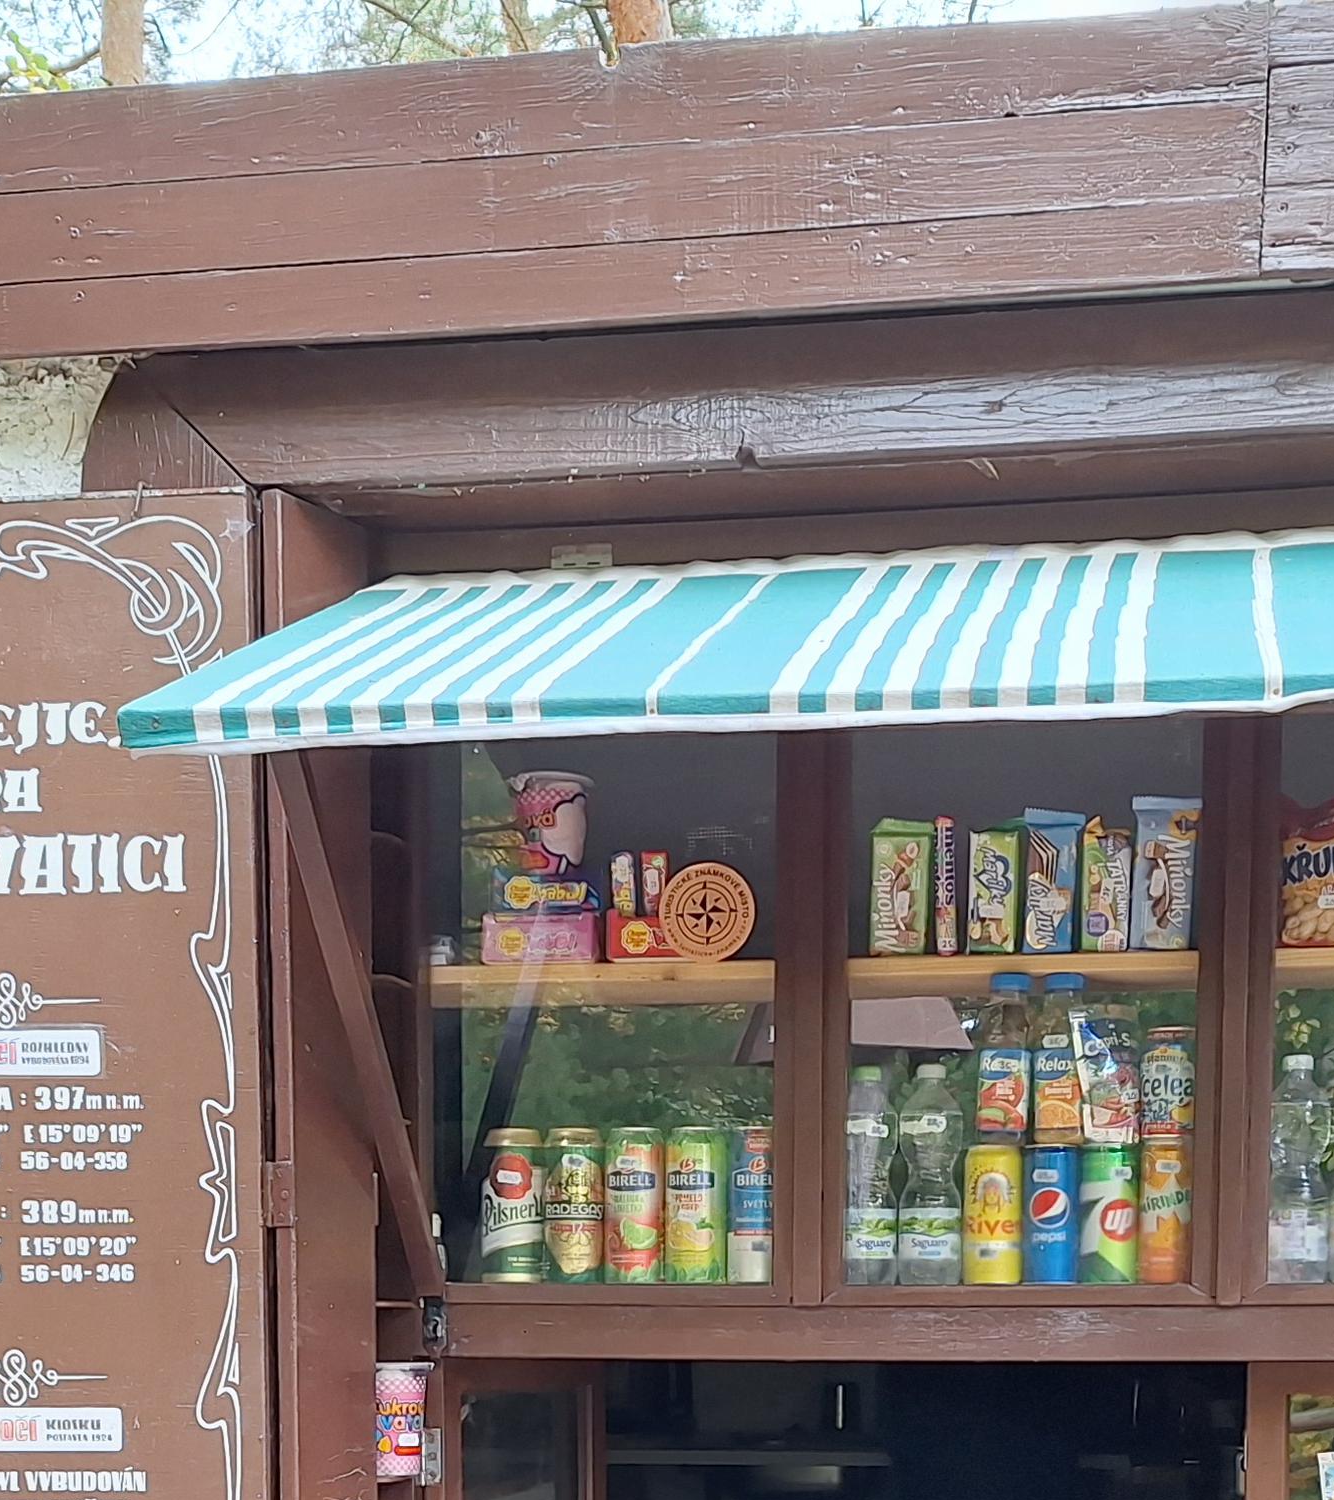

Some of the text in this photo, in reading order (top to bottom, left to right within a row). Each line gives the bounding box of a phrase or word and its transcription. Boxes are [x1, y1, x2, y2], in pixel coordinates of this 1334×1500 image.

[943, 826, 957, 908] mentos
[20, 1150, 128, 1171] 56-04-358
[608, 1174, 653, 1187] BIRELL
[669, 1174, 711, 1186] BIRELL
[856, 1238, 892, 1250] Saguaro
[911, 1238, 948, 1250] Saguaro
[20, 1264, 135, 1283] 56-04-346
[46, 1419, 101, 1431] KIOSKU
[24, 1466, 147, 1492] VYBUDOVÁN
